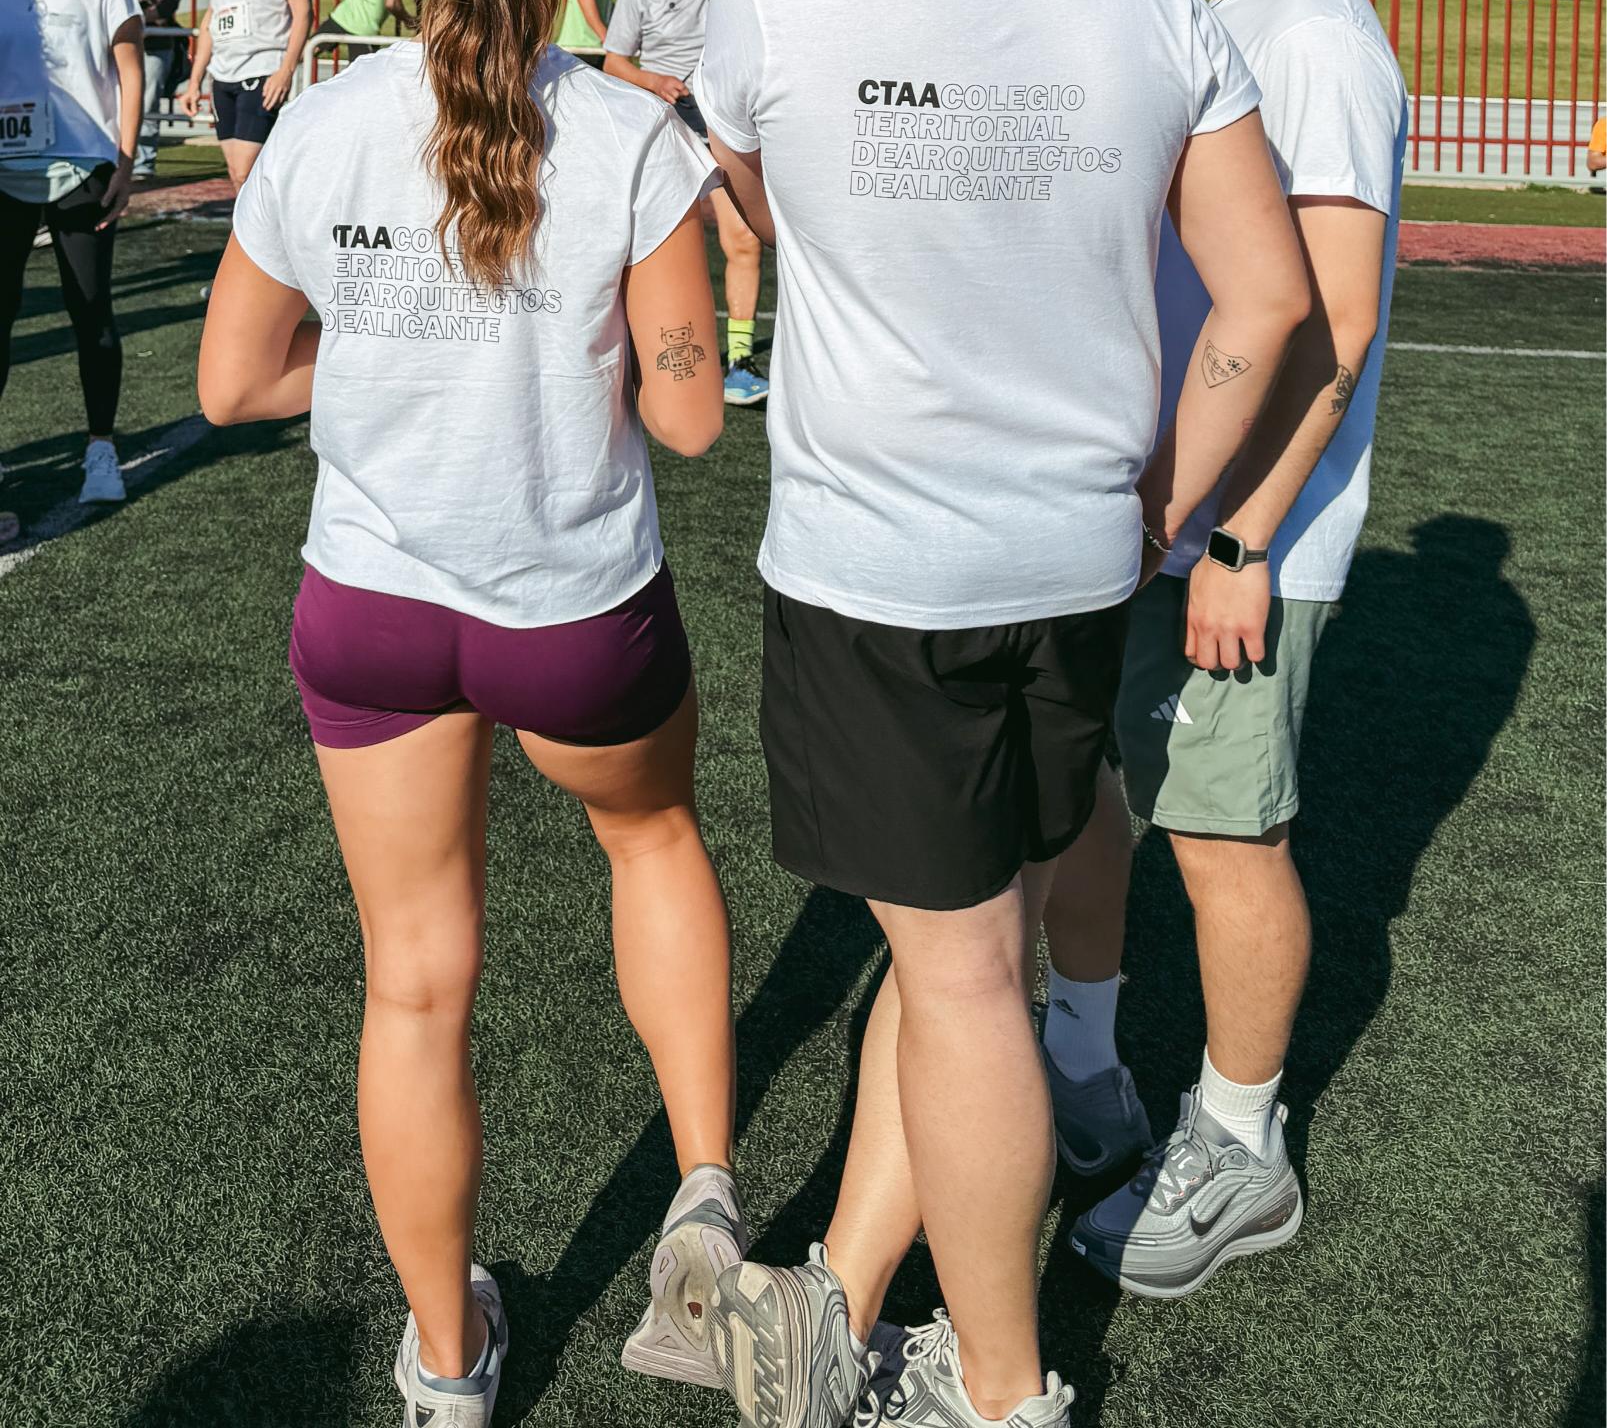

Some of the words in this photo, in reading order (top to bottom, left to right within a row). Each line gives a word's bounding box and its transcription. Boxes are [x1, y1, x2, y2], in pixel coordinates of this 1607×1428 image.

[854, 109, 1070, 142] TERRITORIAL
[851, 140, 1122, 174] DEARQUITECTOS
[850, 170, 1052, 201] DEALICANTE
[328, 281, 562, 314] EARQUITECTOS
